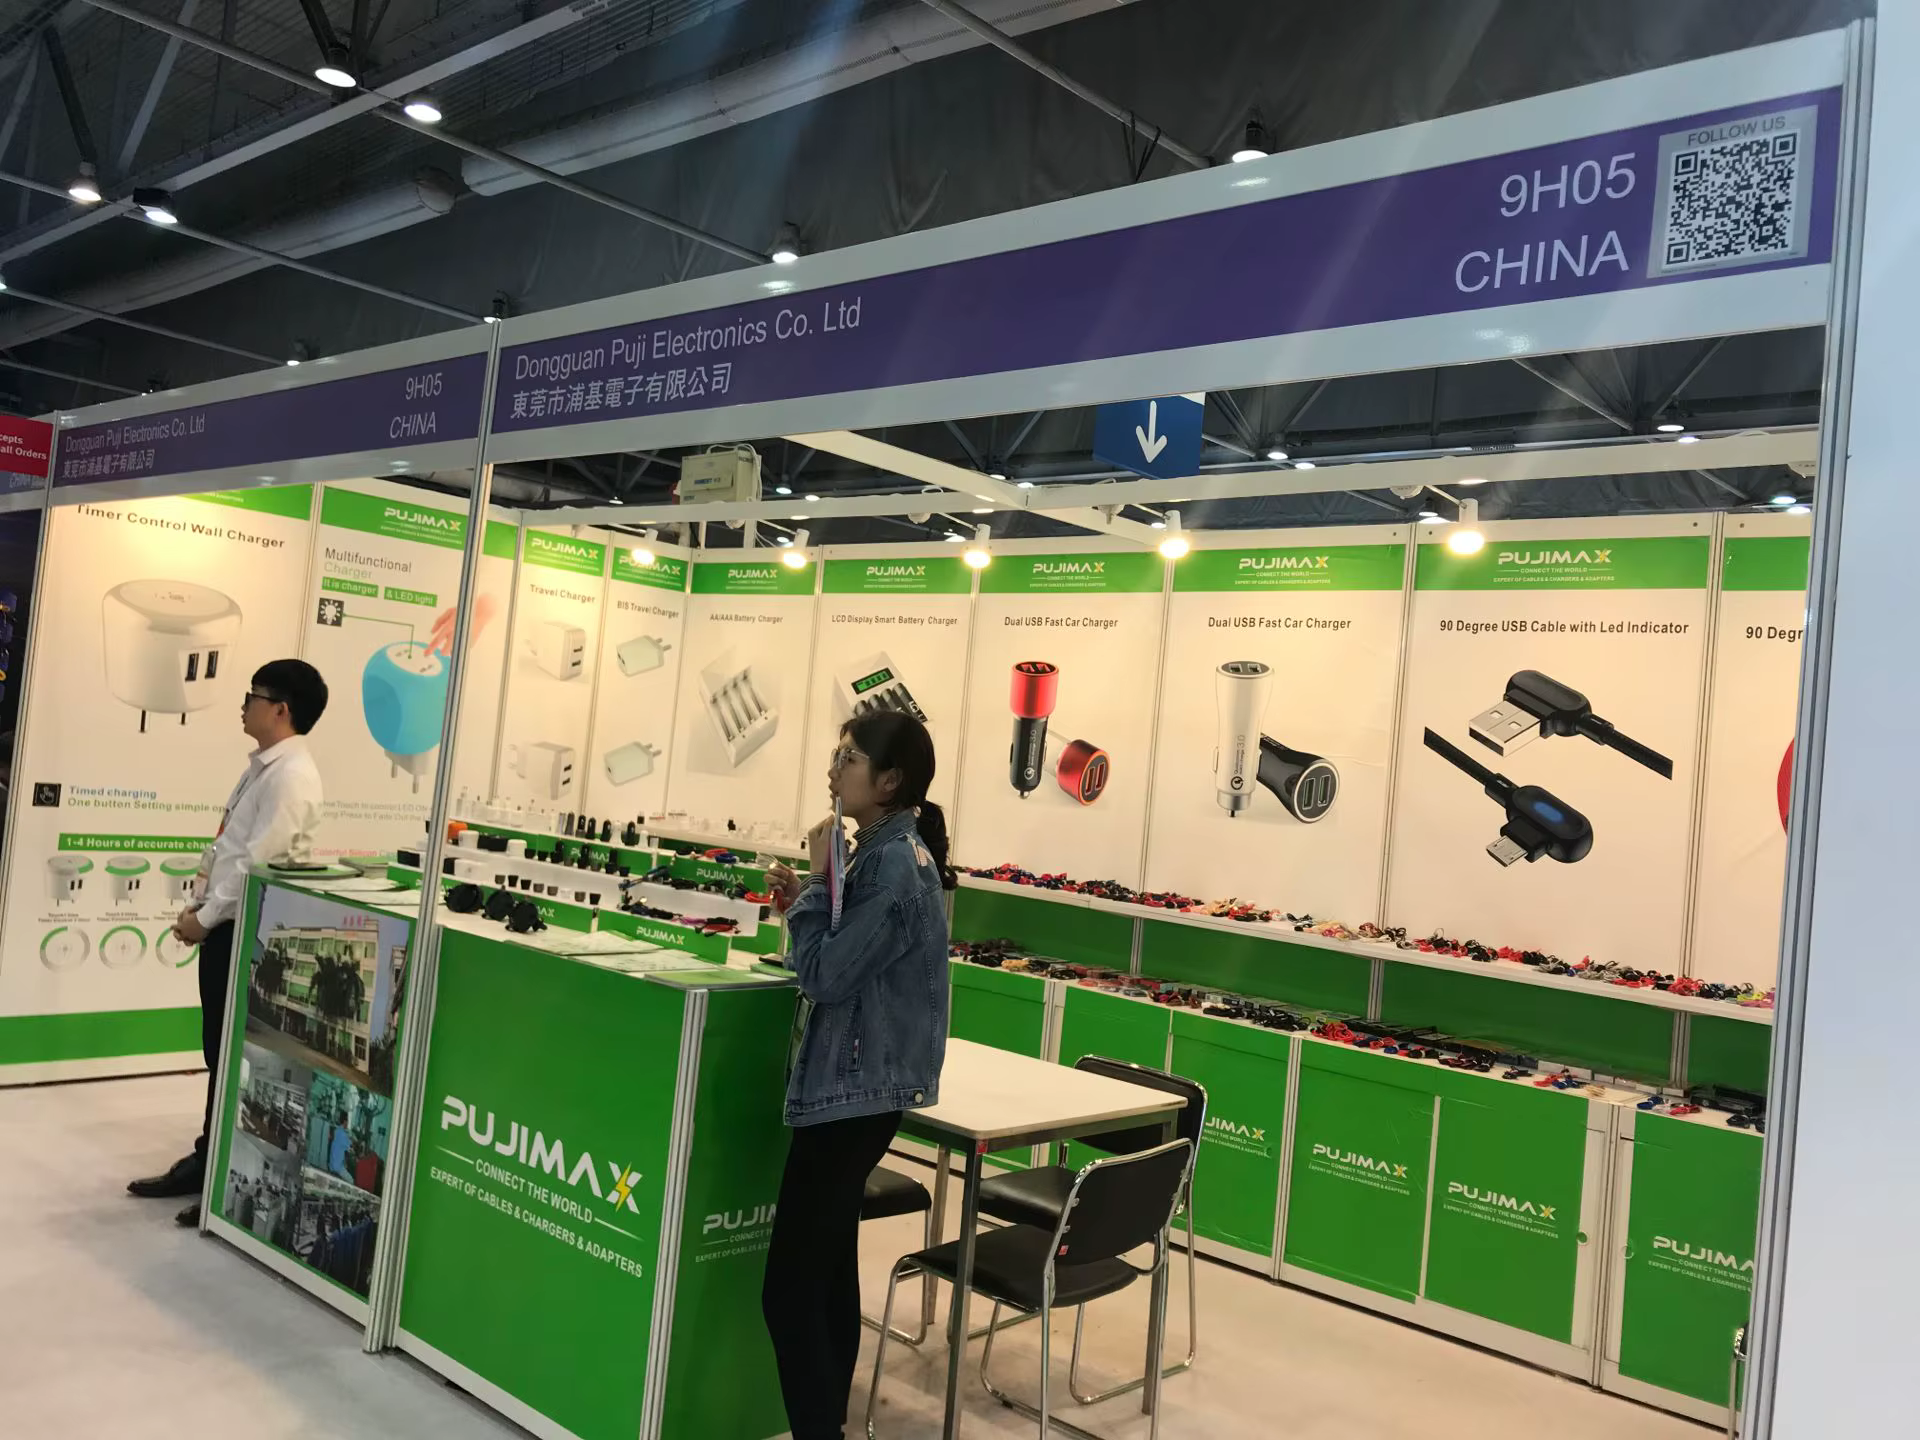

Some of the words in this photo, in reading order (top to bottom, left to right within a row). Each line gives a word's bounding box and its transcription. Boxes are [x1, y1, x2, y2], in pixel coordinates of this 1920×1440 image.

[1687, 121, 1757, 146] FOLLOW
[1762, 115, 1786, 132] US
[1500, 153, 1636, 218] 9H05
[1455, 230, 1630, 294] CHINA
[515, 347, 605, 382] Dongguan
[610, 334, 648, 370] Puji
[652, 317, 767, 359] Electronics
[775, 308, 813, 339] Co.
[823, 296, 862, 332] Ltd
[404, 372, 443, 401] 9H05
[510, 362, 732, 420] 東莞市浦基電子有限公司
[65, 434, 105, 455] Dongguan
[106, 428, 121, 450] Puji
[123, 421, 170, 445] Electronics
[171, 418, 187, 437] Co.
[189, 413, 206, 434] Ltd
[389, 410, 437, 440] CHINA
[15, 447, 47, 460] Orders
[77, 504, 123, 521] Timer
[127, 512, 187, 532] Control
[191, 523, 223, 538] Wall
[227, 529, 286, 549] Charger
[384, 507, 462, 532] PUJIMAX
[531, 538, 599, 560] PUJIMAX
[1498, 549, 1612, 565] PUJIMAX
[325, 547, 412, 573] Multifunctional
[1032, 561, 1106, 574] PUJIMAX
[1238, 556, 1329, 570] PUJIMAX
[323, 561, 373, 579] Charger
[728, 568, 778, 579] PUJIMAX
[866, 565, 926, 576] PUJIMAX
[342, 581, 377, 594] charger
[395, 591, 413, 601] LED
[530, 584, 558, 597] Travel
[559, 589, 596, 604] Charger
[631, 602, 651, 614] Travel
[652, 606, 680, 620] Charger
[734, 614, 756, 624] Battery
[757, 614, 784, 625] Charger
[831, 615, 846, 624] LCD
[847, 615, 873, 626] Display
[874, 615, 896, 625] Smart
[898, 615, 925, 627] Battery
[927, 616, 958, 627] Charger
[1004, 616, 1023, 627] Dual
[1024, 616, 1043, 627] USB
[1045, 616, 1064, 628] Fast
[1065, 617, 1081, 628] Car
[1082, 617, 1119, 630] Charger
[1208, 617, 1231, 628] Dual
[1233, 617, 1256, 628] USB
[1258, 617, 1282, 629] Fast
[1284, 617, 1303, 629] Car
[1305, 617, 1352, 631] Charger
[1440, 620, 1453, 632] 90
[1456, 620, 1498, 635] Degree
[1501, 620, 1528, 632] USB
[1530, 620, 1566, 633] Cable
[1570, 620, 1596, 633] with
[1600, 621, 1624, 634] Led
[1627, 621, 1689, 634] Indicator
[1745, 626, 1763, 639] 90
[69, 786, 104, 797] Timed
[107, 787, 157, 799] charging
[68, 798, 91, 808] One
[94, 798, 131, 809] button
[134, 800, 172, 812] Setting
[174, 801, 210, 813] simple
[66, 838, 84, 847] 1-4
[86, 838, 121, 848] Hours
[123, 838, 135, 848] of
[137, 838, 185, 849] accurate
[696, 867, 745, 885] PUJIMAX
[636, 926, 685, 946] PUJIMAX
[441, 1094, 643, 1215] PUJIMAX
[1312, 1143, 1408, 1179] PUJIMAX
[1330, 1162, 1356, 1173] CONNECT
[1356, 1169, 1366, 1177] THE
[1367, 1171, 1388, 1182] WORLD
[475, 1158, 527, 1193] CONNECT
[527, 1181, 550, 1204] THE
[550, 1192, 593, 1224] WORLD
[1448, 1181, 1557, 1221] PUJIMAX
[1468, 1202, 1497, 1214] CONNECT
[1498, 1209, 1509, 1217] THE
[1510, 1212, 1533, 1224] WORLD
[430, 1166, 464, 1191] EXPERT
[464, 1181, 477, 1197] OF
[477, 1188, 513, 1216] CABLES
[513, 1206, 521, 1220] &
[522, 1210, 576, 1246] CHARGERS
[576, 1236, 585, 1250] &
[585, 1240, 643, 1279] ADAPTERS
[729, 1229, 764, 1243] CONNECT
[1678, 1259, 1713, 1273] CONNECT
[1714, 1268, 1728, 1277] THE
